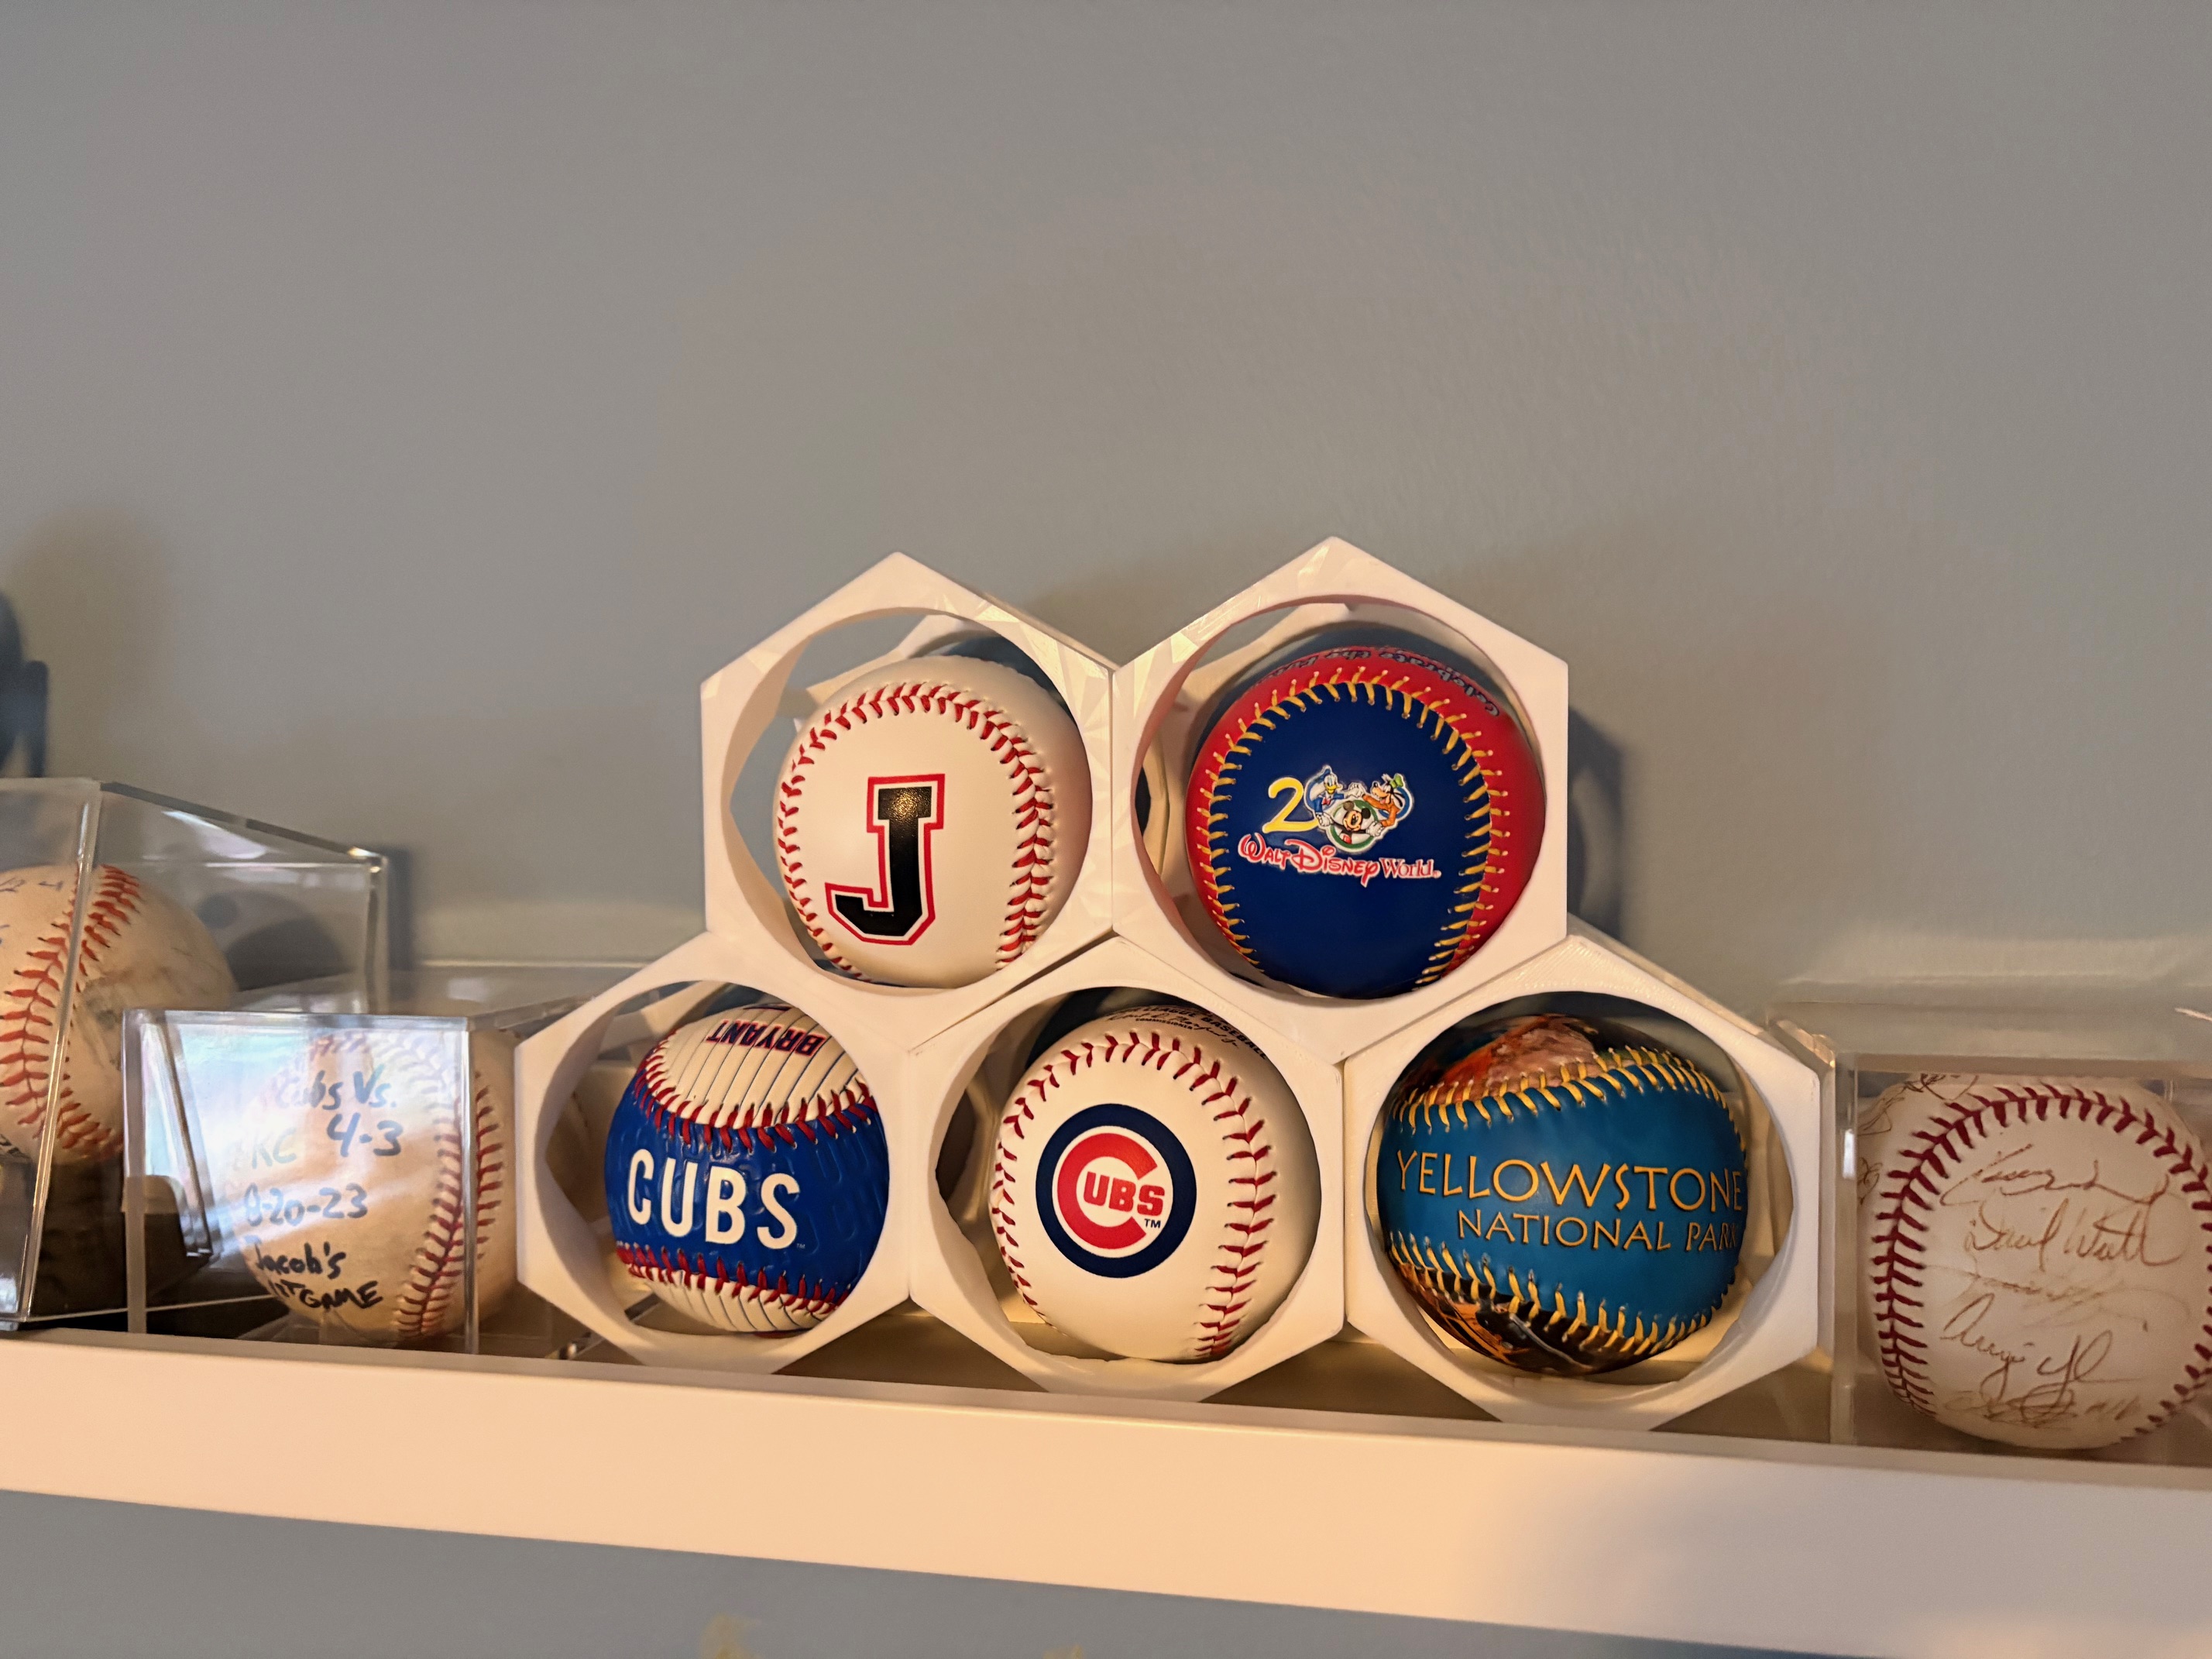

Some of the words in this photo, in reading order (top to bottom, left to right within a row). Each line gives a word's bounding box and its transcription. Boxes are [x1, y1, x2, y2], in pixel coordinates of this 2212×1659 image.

[825, 773, 946, 946] J
[706, 1018, 826, 1056] BRYANT
[325, 1111, 404, 1158] 4-3
[627, 1148, 801, 1250] CUBS
[1396, 1149, 1743, 1213] YELLOWSTONE
[242, 1182, 369, 1227] 8-20-23
[1457, 1208, 1672, 1251] NATIONAL
[243, 1235, 347, 1279] Jacob's
[299, 1280, 384, 1312] GAME
